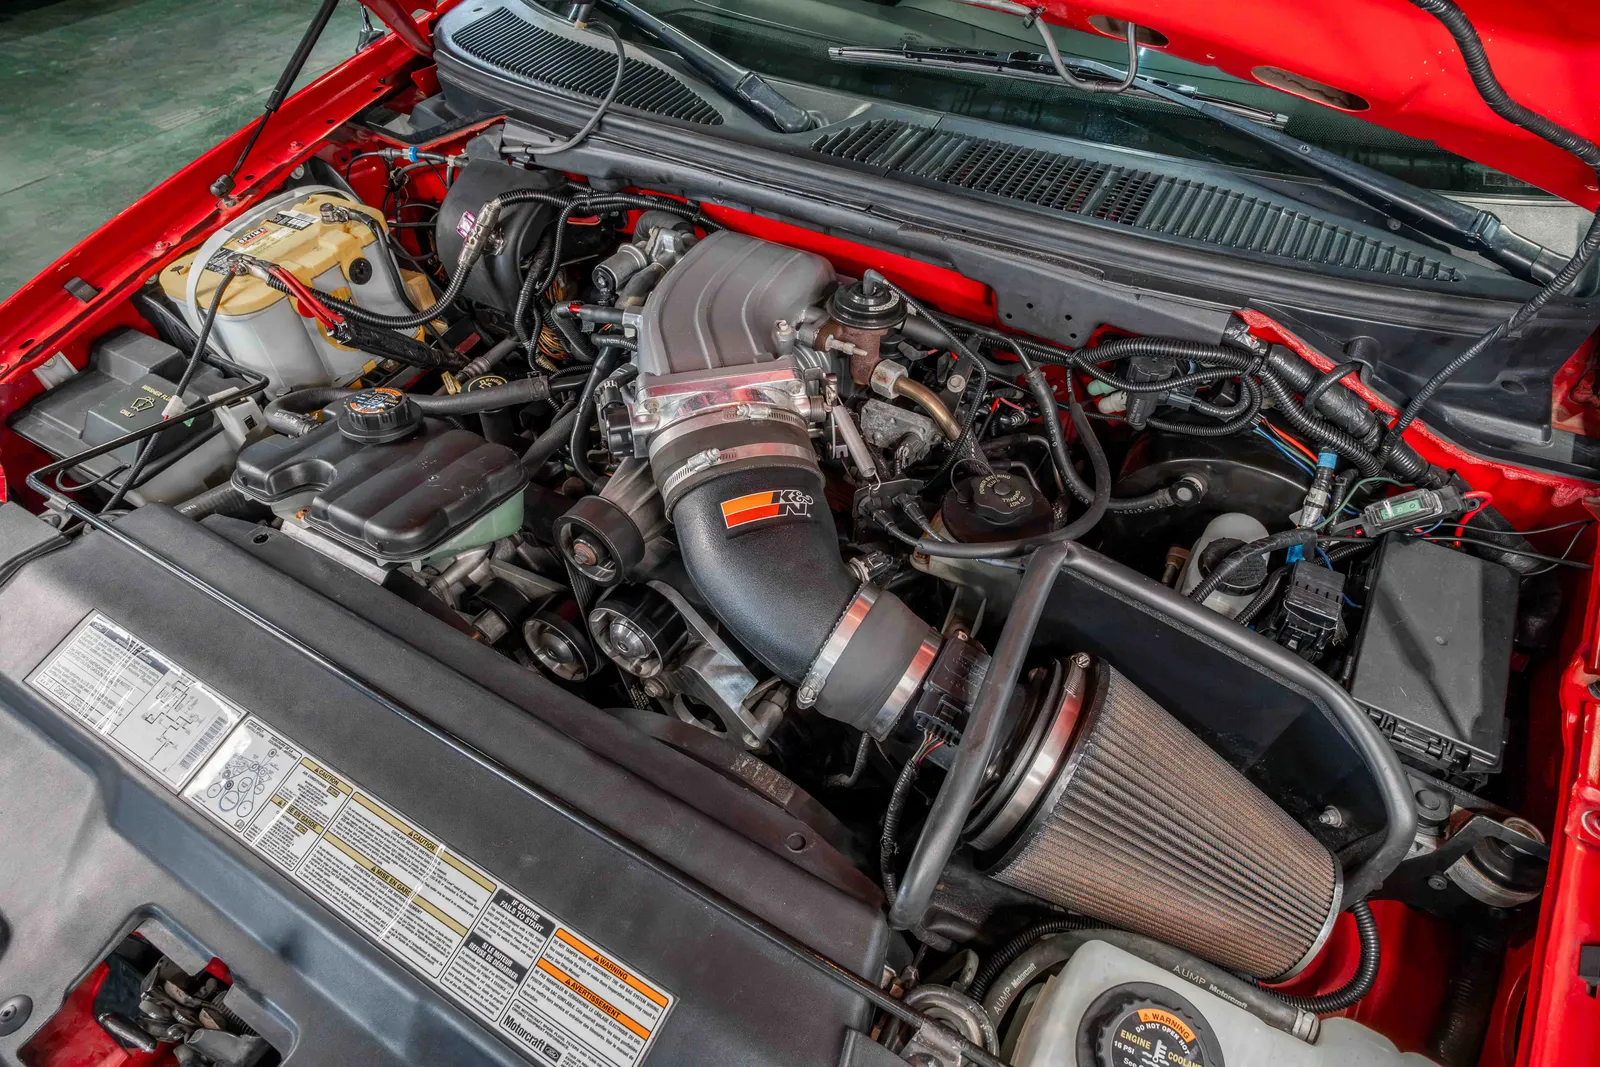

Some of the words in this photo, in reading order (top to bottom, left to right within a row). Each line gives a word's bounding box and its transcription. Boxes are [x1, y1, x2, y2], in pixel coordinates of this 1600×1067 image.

[142, 384, 163, 397] WASHER
[120, 409, 135, 418] ONLY
[318, 769, 339, 785] CAUTION
[293, 809, 301, 818] EN
[299, 814, 317, 829] GARDE
[390, 829, 406, 841] COOLANT
[405, 839, 419, 850] SERVICE
[412, 832, 435, 851] CAUTION
[375, 868, 389, 881] MISE
[388, 877, 397, 886] EN
[396, 883, 411, 896] GARD
[499, 899, 517, 914] FAILS
[515, 910, 525, 920] TO
[523, 916, 544, 932] START
[510, 898, 519, 907] IF
[517, 903, 540, 921] ENGINE
[467, 941, 487, 958] REFUSE
[484, 953, 494, 963] DE
[491, 956, 519, 980] DÉMARRER
[481, 941, 489, 950] SI
[486, 945, 495, 954] LE
[492, 949, 513, 967] MOTEUR
[564, 946, 578, 958] TAMPER
[577, 955, 587, 964] WITH
[591, 964, 611, 980] DISCONNECT
[624, 987, 633, 995] BAG
[632, 992, 646, 1004] SYSTEM
[598, 957, 628, 980] WARNING
[570, 981, 621, 1019] AVERTISSEMENT
[993, 986, 1012, 1016] AUMP
[1011, 962, 1037, 989] Motorcraft
[1173, 965, 1206, 985] AUMP
[1209, 984, 1248, 1009] Motorcraft
[502, 1014, 546, 1051] Motorcraft
[1135, 1024, 1145, 1033] DO
[1146, 1022, 1160, 1030] NOT
[1161, 1025, 1179, 1040] OPEN
[1178, 1039, 1190, 1055] HOT
[1151, 1012, 1190, 1040] WARNING
[1114, 1040, 1123, 1049] 16
[1123, 1044, 1135, 1055] PSI
[1120, 1029, 1152, 1050] ENGINE
